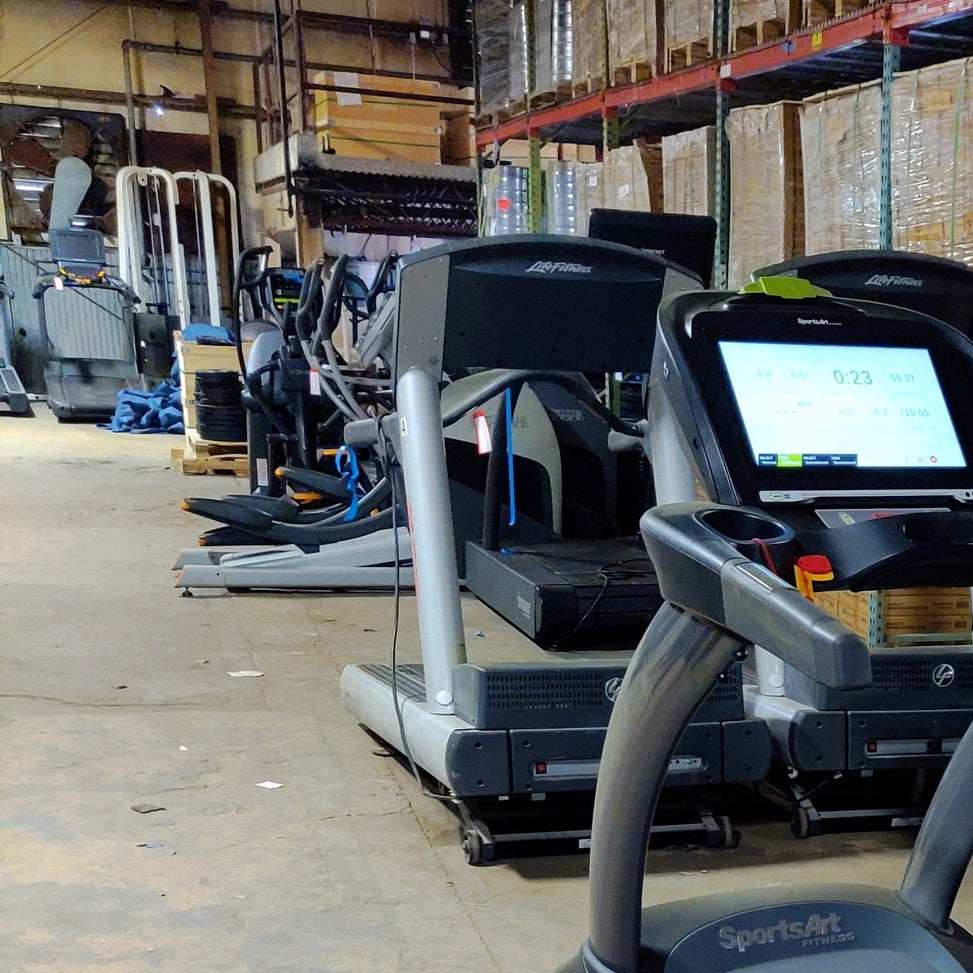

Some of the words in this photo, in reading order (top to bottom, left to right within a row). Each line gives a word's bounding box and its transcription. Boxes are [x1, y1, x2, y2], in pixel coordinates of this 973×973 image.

[832, 369, 873, 386] 0:23
[719, 912, 842, 953] SportsArt
[801, 931, 856, 948] FITNESS
